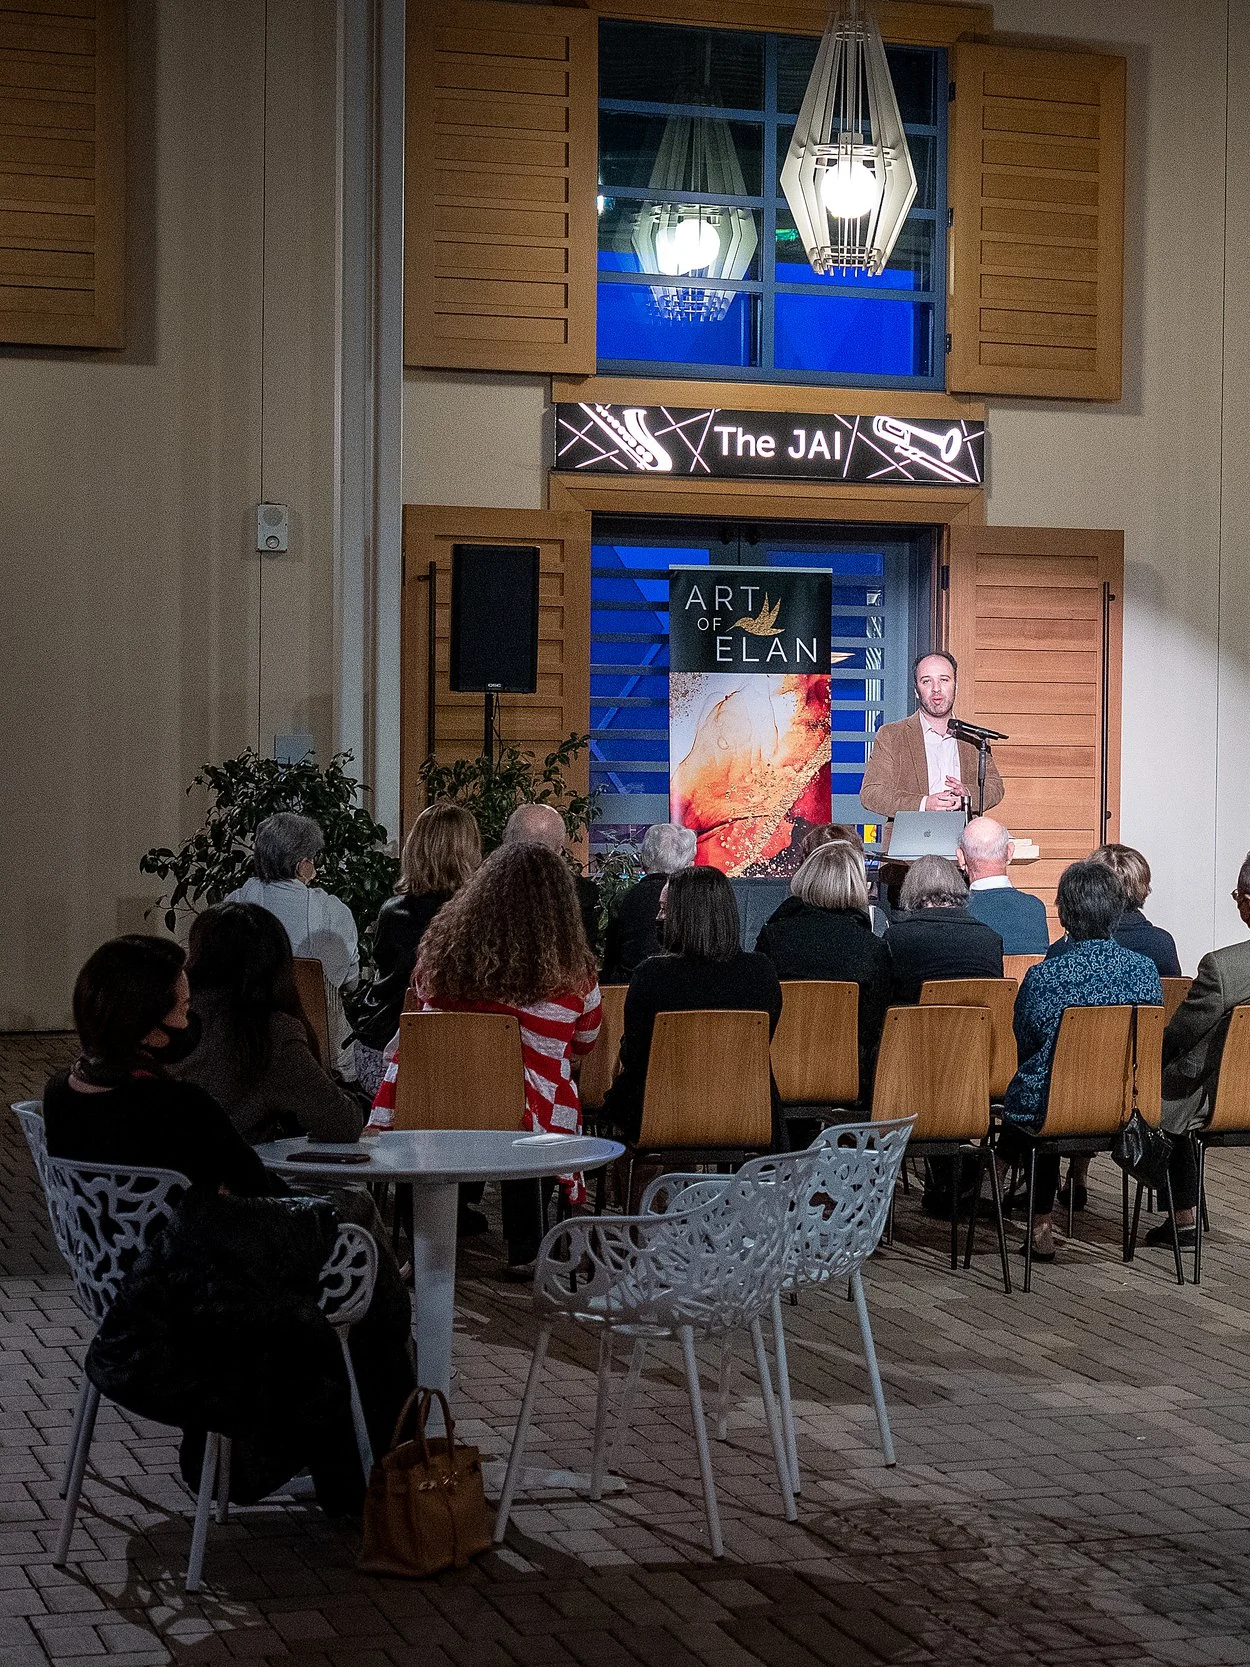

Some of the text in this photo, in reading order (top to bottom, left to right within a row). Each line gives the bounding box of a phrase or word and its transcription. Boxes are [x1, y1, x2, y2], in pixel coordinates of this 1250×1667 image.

[713, 425, 842, 461] The JAI
[684, 584, 760, 612] ART
[697, 617, 722, 631] OF
[716, 635, 818, 664] ELAN
